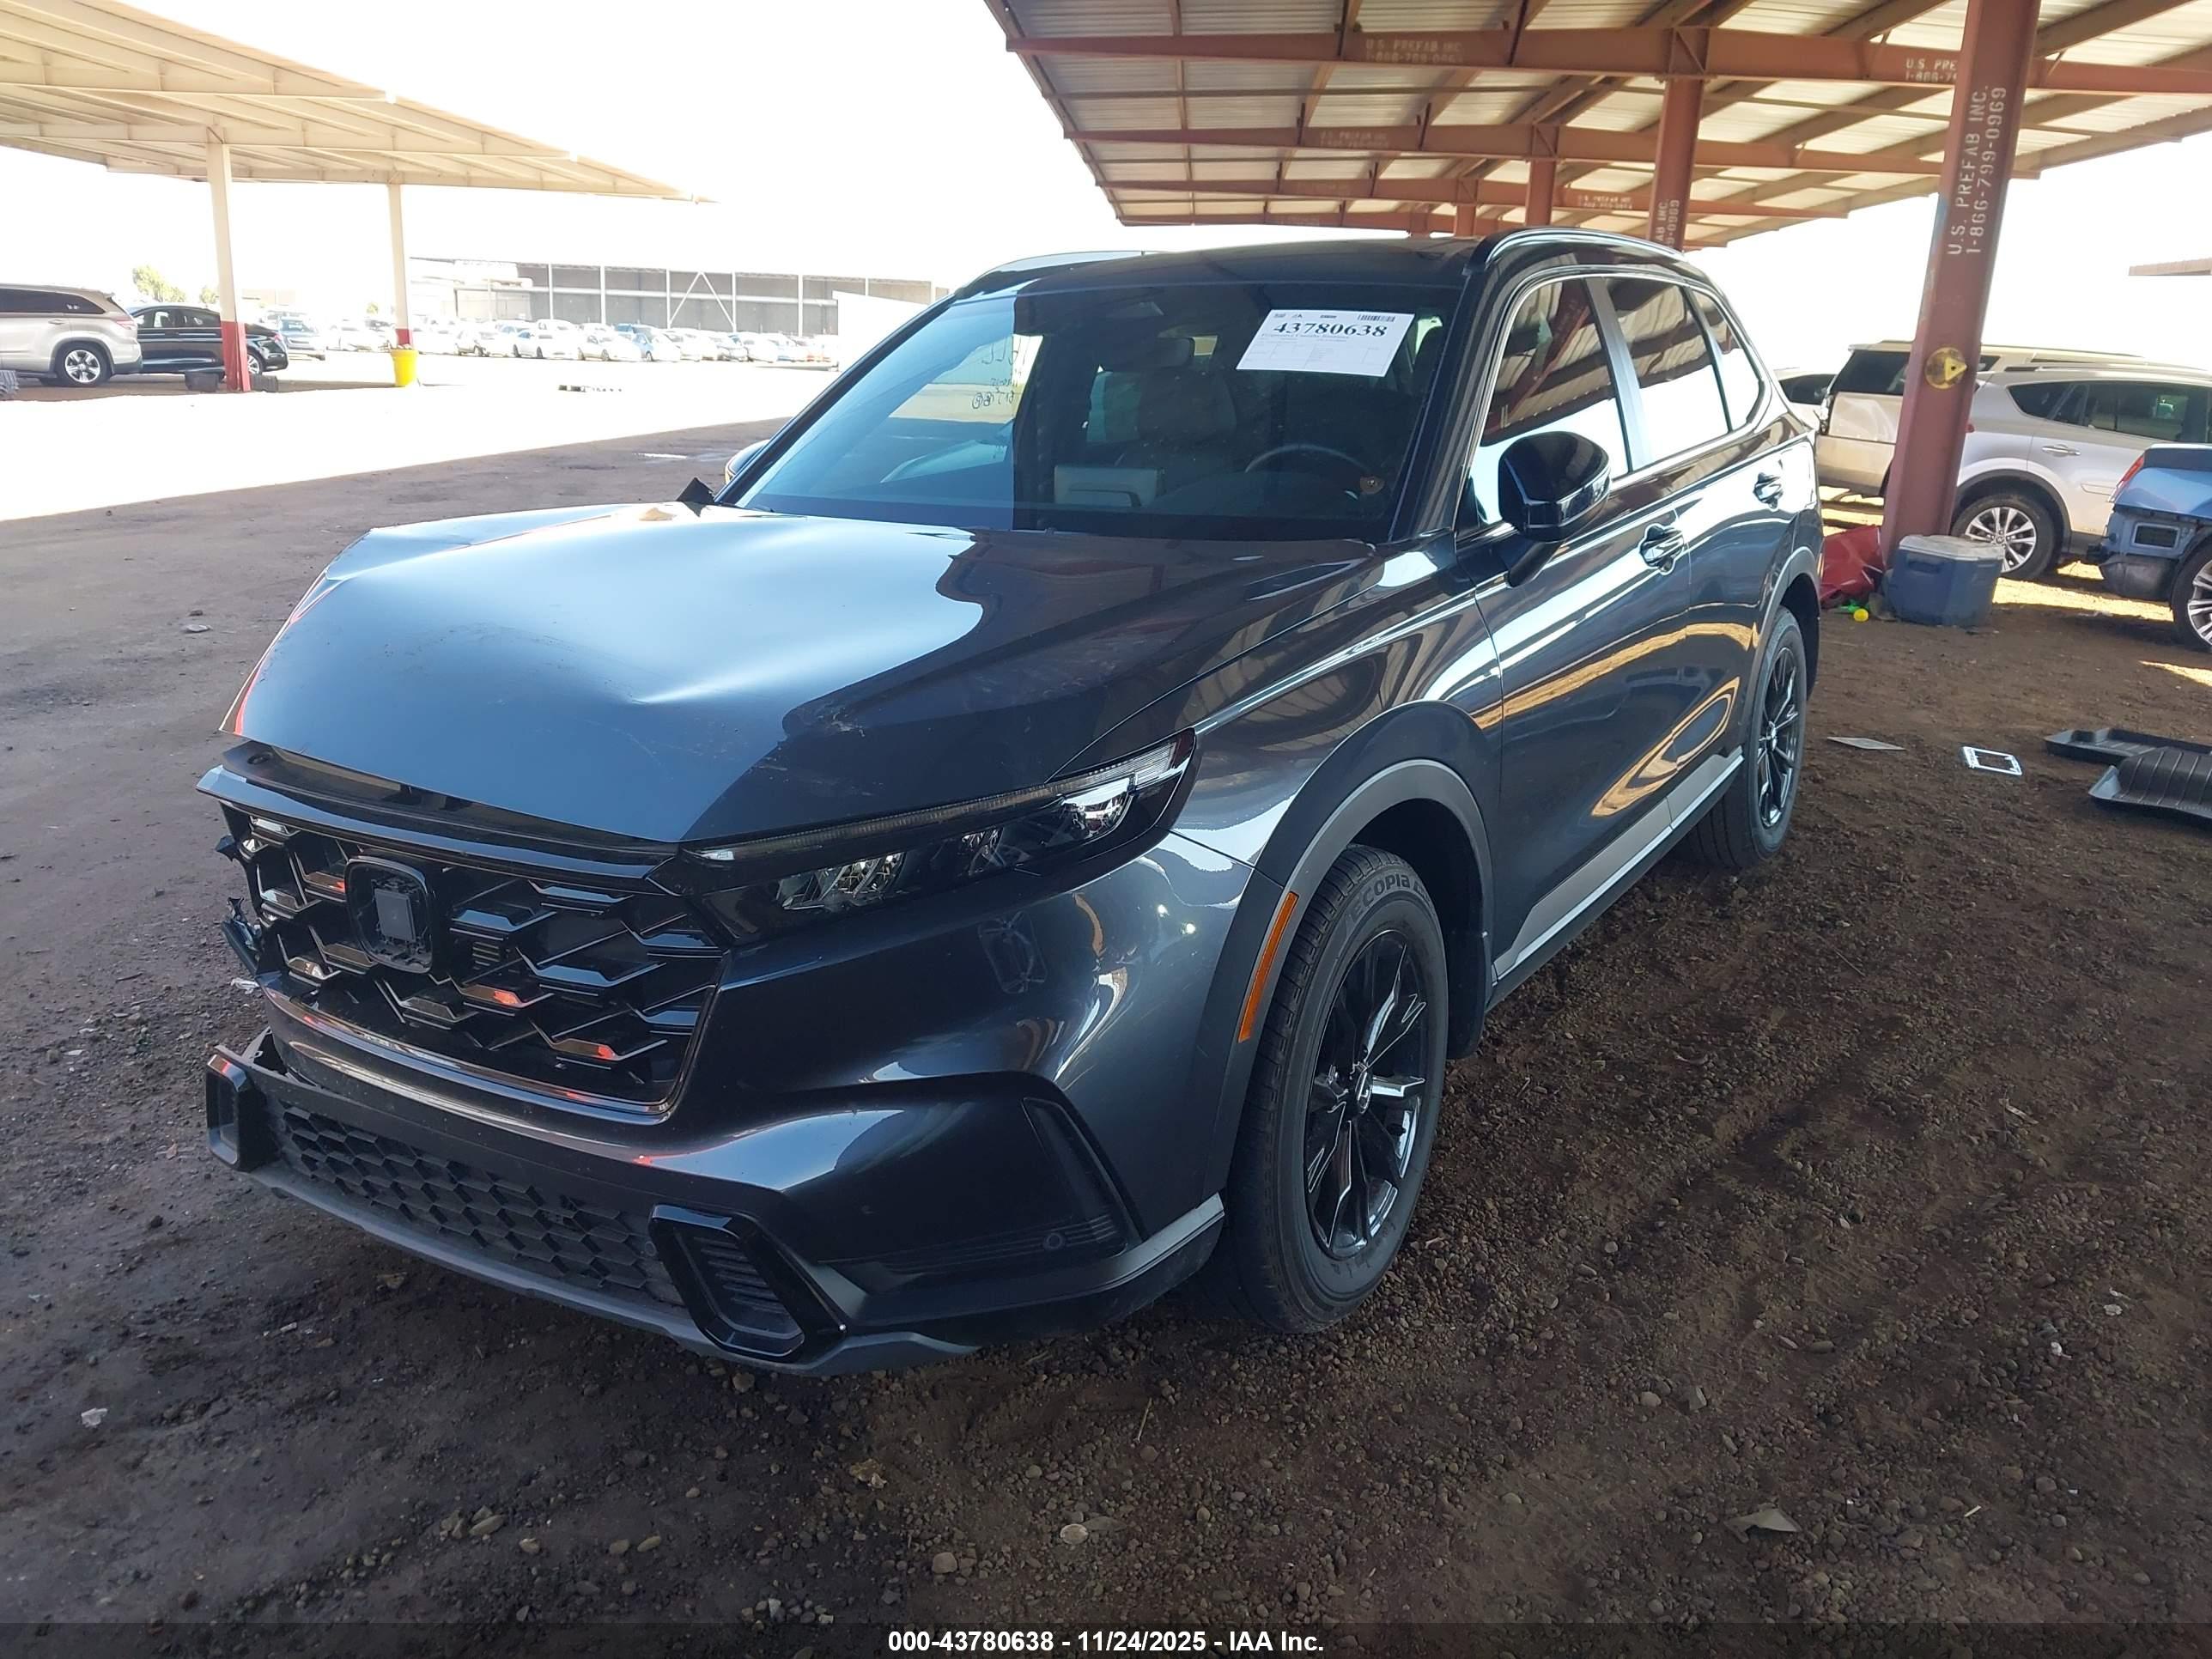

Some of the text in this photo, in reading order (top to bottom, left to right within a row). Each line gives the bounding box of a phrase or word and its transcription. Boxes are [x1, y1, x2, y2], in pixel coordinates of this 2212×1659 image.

[1948, 86, 1988, 255] U.S. PREFAB INC.
[1966, 87, 2007, 253] 1-866-799-0969
[1273, 322, 1388, 337] 43780638
